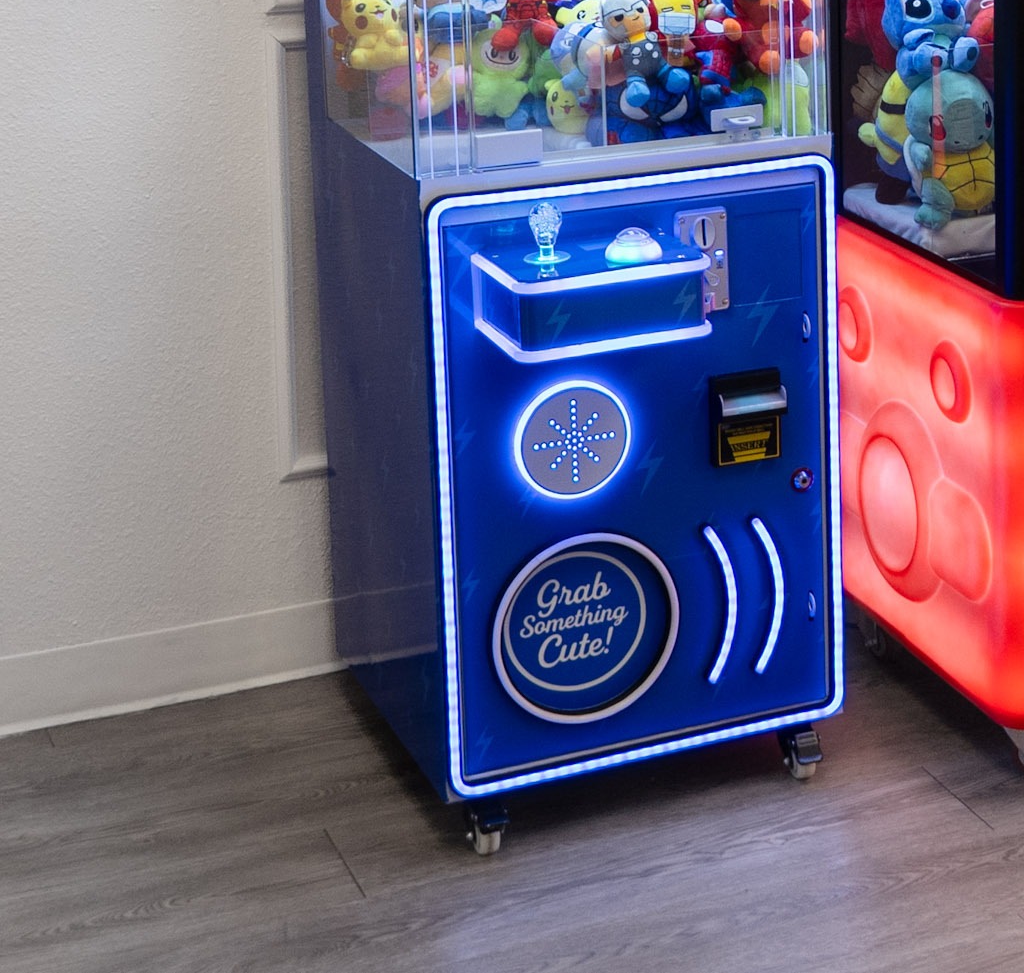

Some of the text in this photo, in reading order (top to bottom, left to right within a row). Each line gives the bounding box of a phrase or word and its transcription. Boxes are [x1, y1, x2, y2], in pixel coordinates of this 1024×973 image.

[730, 439, 767, 452] INSERT
[537, 571, 611, 618] Grab
[520, 604, 629, 638] Something
[538, 626, 614, 668] Cute!
